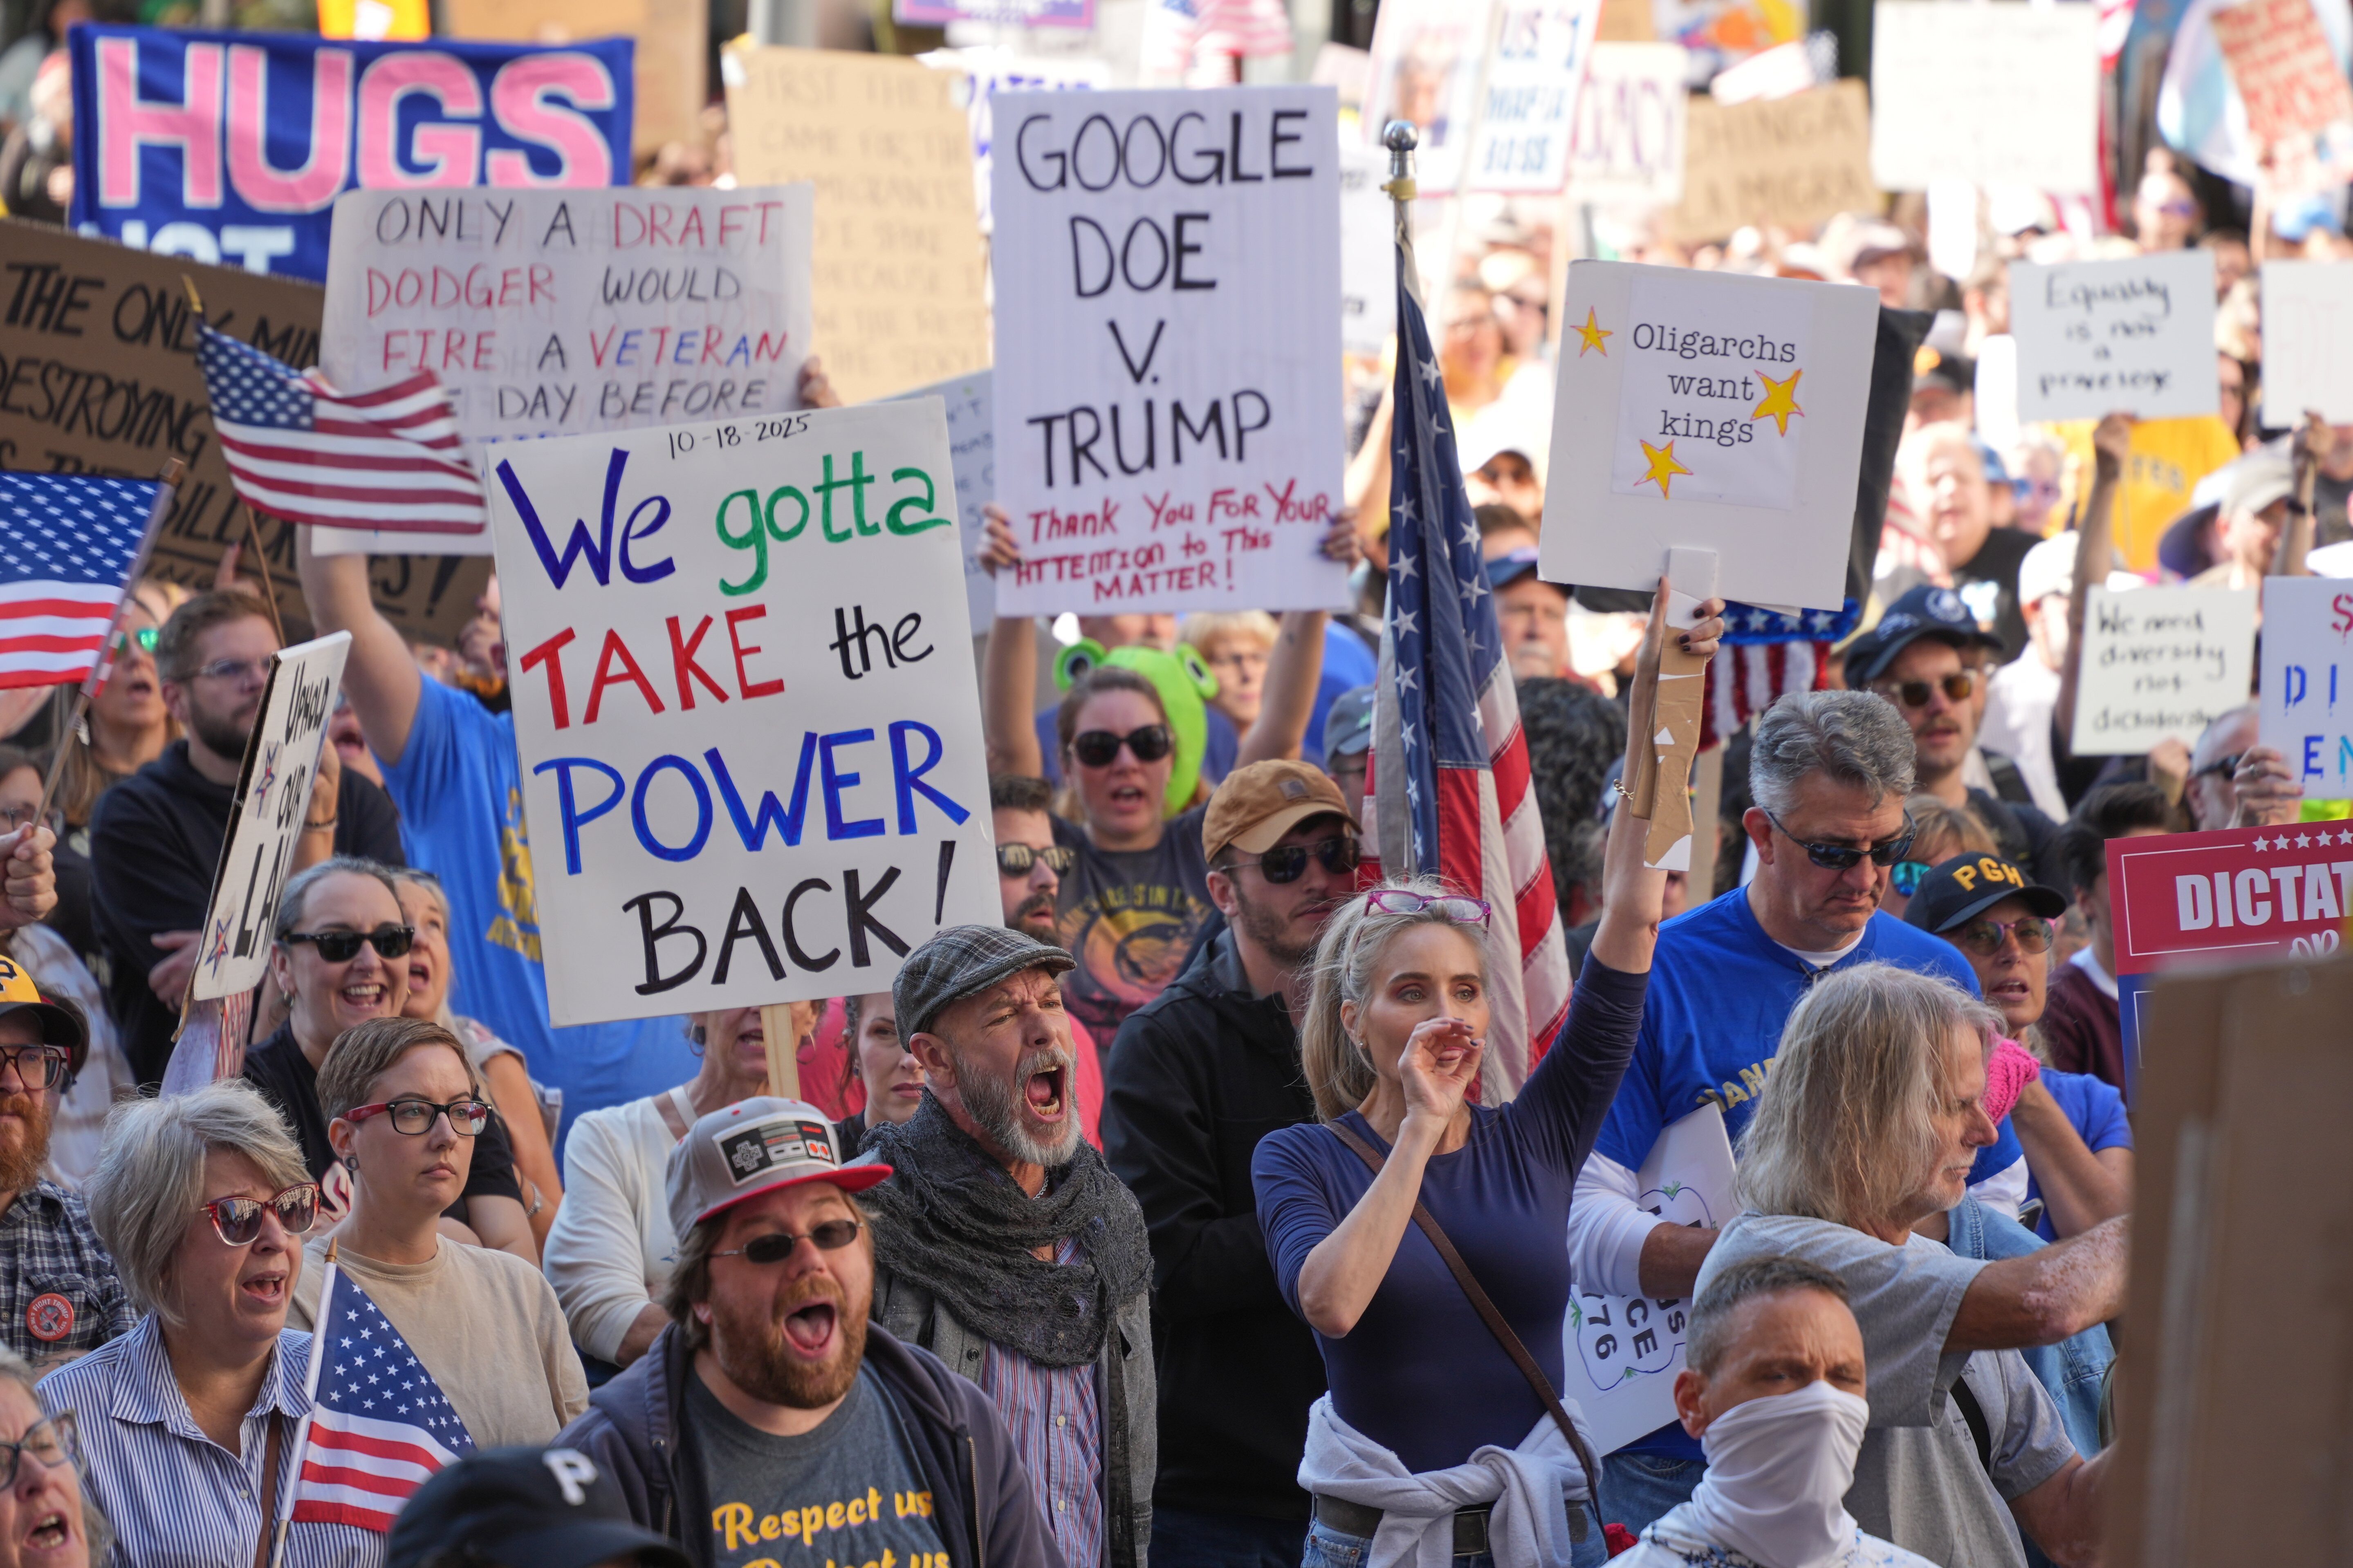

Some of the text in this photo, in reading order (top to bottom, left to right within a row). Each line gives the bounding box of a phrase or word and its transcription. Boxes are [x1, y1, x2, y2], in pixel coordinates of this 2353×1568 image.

[96, 37, 616, 213] HUGS
[1016, 110, 1313, 193] GOOGLE
[375, 196, 513, 246] ONLY
[543, 202, 577, 247] A
[614, 201, 783, 249] DRAFT
[1069, 211, 1217, 299] DOE
[4, 262, 105, 338] THE
[366, 262, 741, 318] DODGER WOULD
[382, 330, 498, 372] FIRE
[537, 333, 568, 371] A
[590, 324, 789, 369] VETERAN
[1107, 319, 1165, 384] V.
[1633, 323, 1796, 363] Oligarchs
[498, 382, 579, 426] DAY
[599, 378, 768, 421] BEFORE
[1667, 374, 1754, 401] want
[1027, 390, 1271, 488] TRUMP
[1659, 410, 1754, 447] kings
[495, 447, 952, 596] We gotta
[1181, 532, 1207, 559] to
[2097, 599, 2135, 636] We
[519, 603, 935, 731] TAKE the
[277, 763, 306, 830] OUR
[533, 720, 971, 876] POWER
[1951, 858, 2024, 891] PGH
[53, 1299, 69, 1318] TRUMP
[541, 1448, 599, 1506] P
[712, 1486, 933, 1550] Respect us
